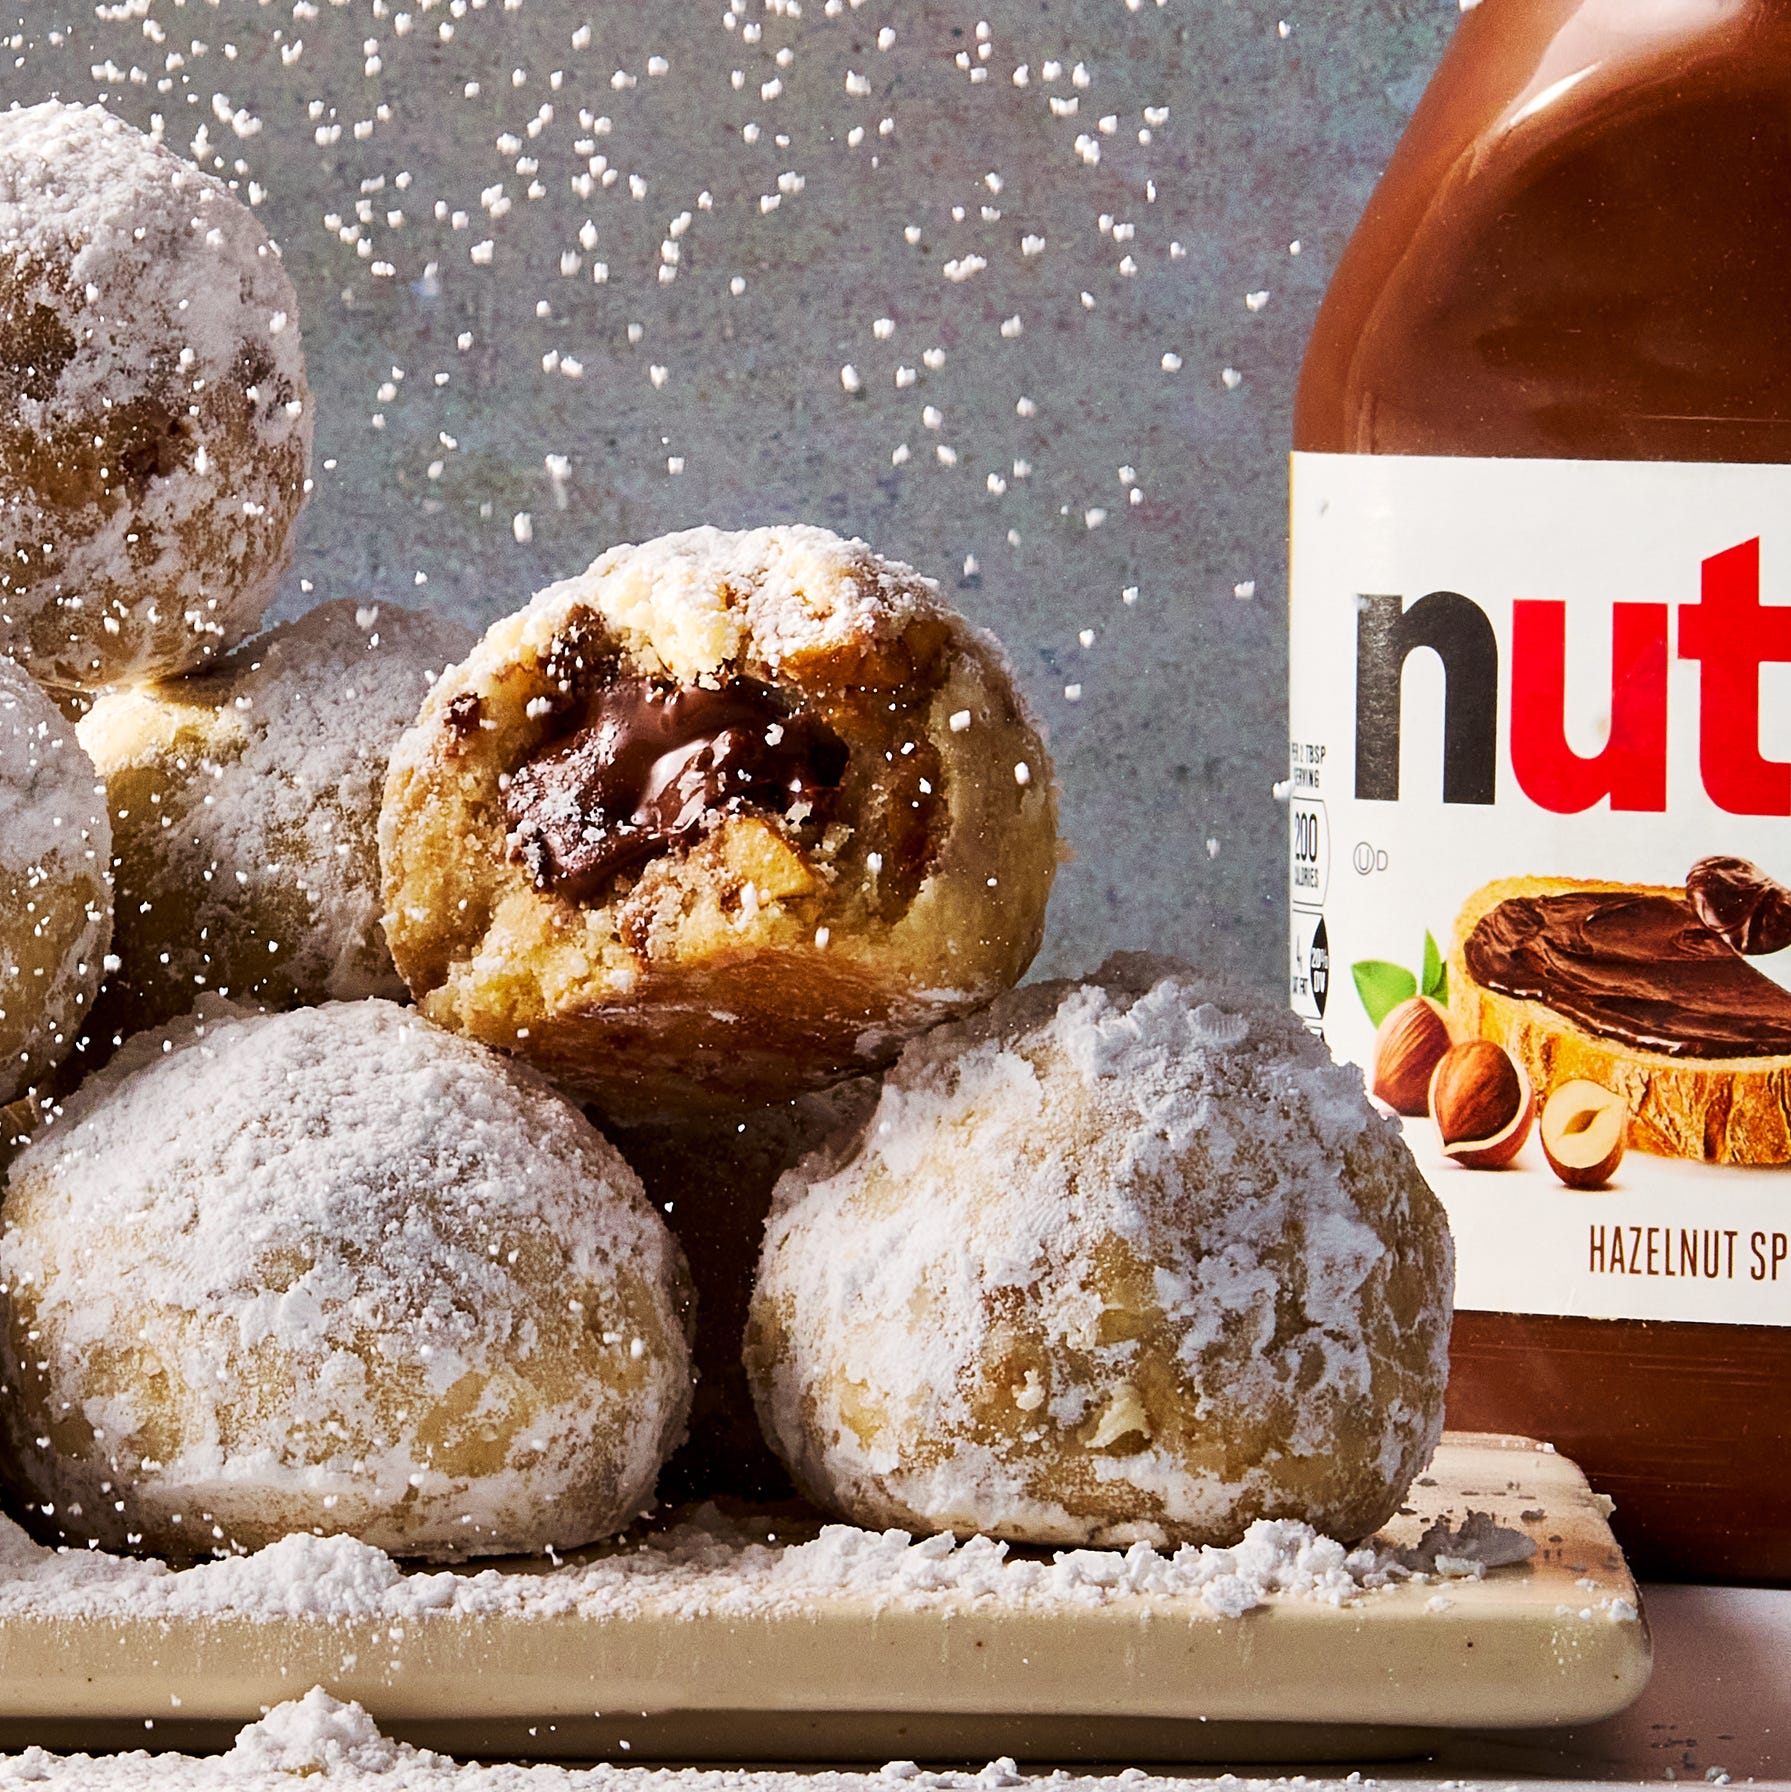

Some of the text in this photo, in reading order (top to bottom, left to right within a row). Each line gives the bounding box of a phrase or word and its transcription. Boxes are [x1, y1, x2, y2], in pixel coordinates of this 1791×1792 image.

[1355, 535, 1791, 816] nut
[1305, 744, 1326, 764] TBSP
[1295, 812, 1317, 862] 200
[1313, 970, 1326, 993] DV
[1589, 1224, 1788, 1281] HAZELNUT SP
